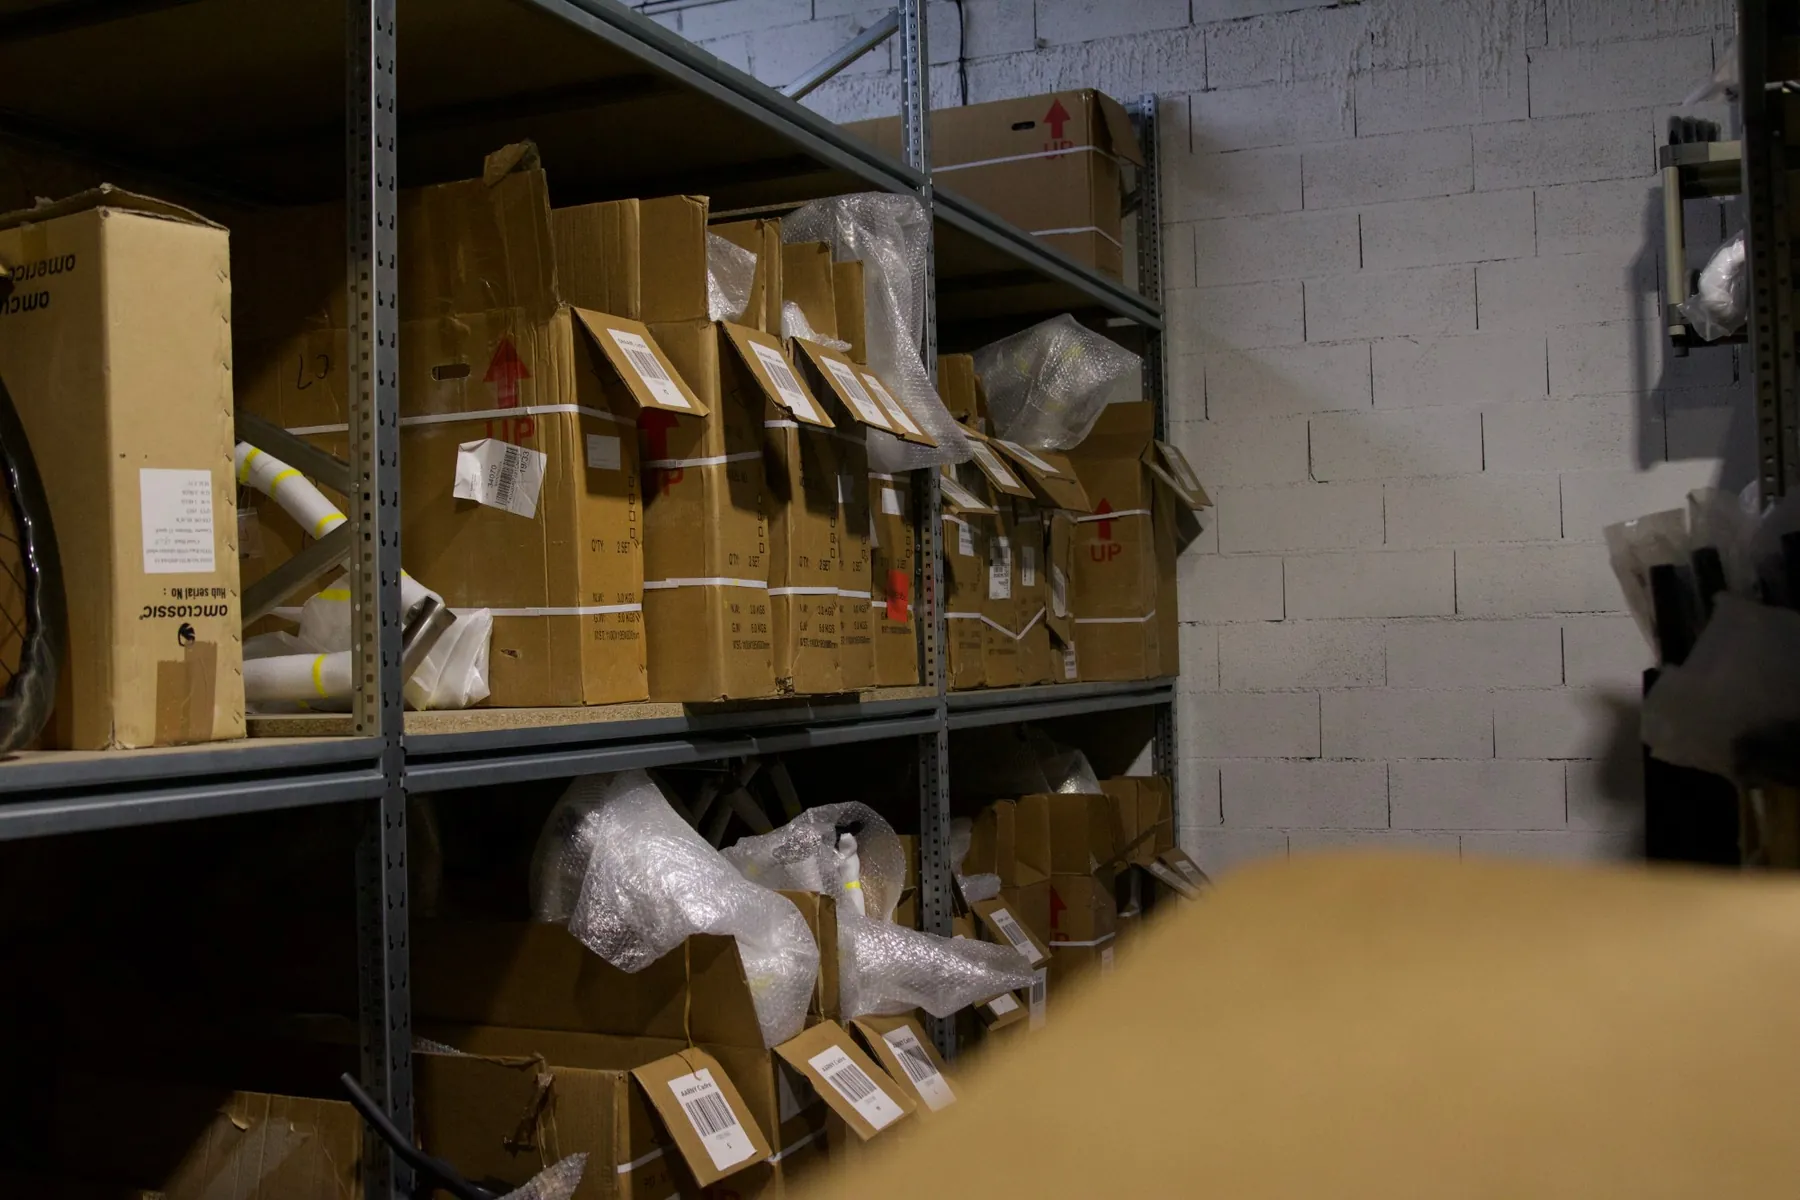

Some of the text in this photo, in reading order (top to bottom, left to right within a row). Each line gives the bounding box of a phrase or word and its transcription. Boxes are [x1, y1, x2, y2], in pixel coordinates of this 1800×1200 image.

[1043, 140, 1074, 159] UP
[1090, 543, 1122, 563] UP
[185, 588, 209, 600] serial
[211, 588, 226, 600] Hub
